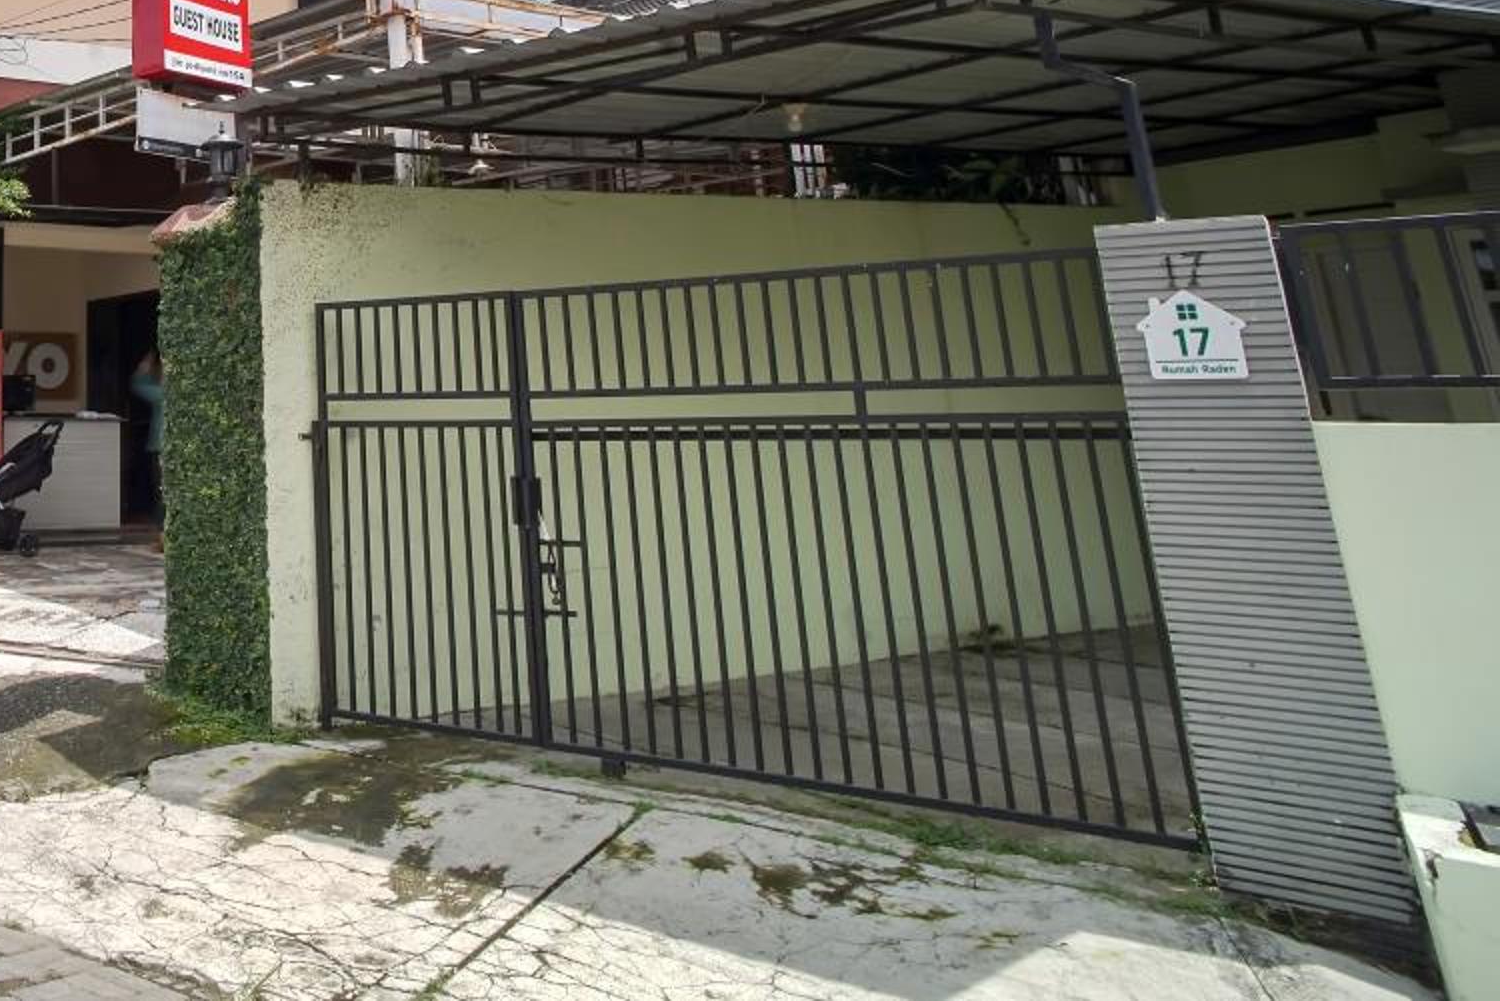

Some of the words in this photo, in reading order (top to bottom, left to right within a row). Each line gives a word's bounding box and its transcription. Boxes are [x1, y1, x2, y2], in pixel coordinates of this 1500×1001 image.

[173, 5, 204, 33] GUEST
[206, 17, 240, 43] HOUSE
[1164, 251, 1205, 289] 17
[1172, 327, 1209, 357] 17
[1161, 364, 1199, 375] Rumah
[1201, 364, 1237, 375] Raden
